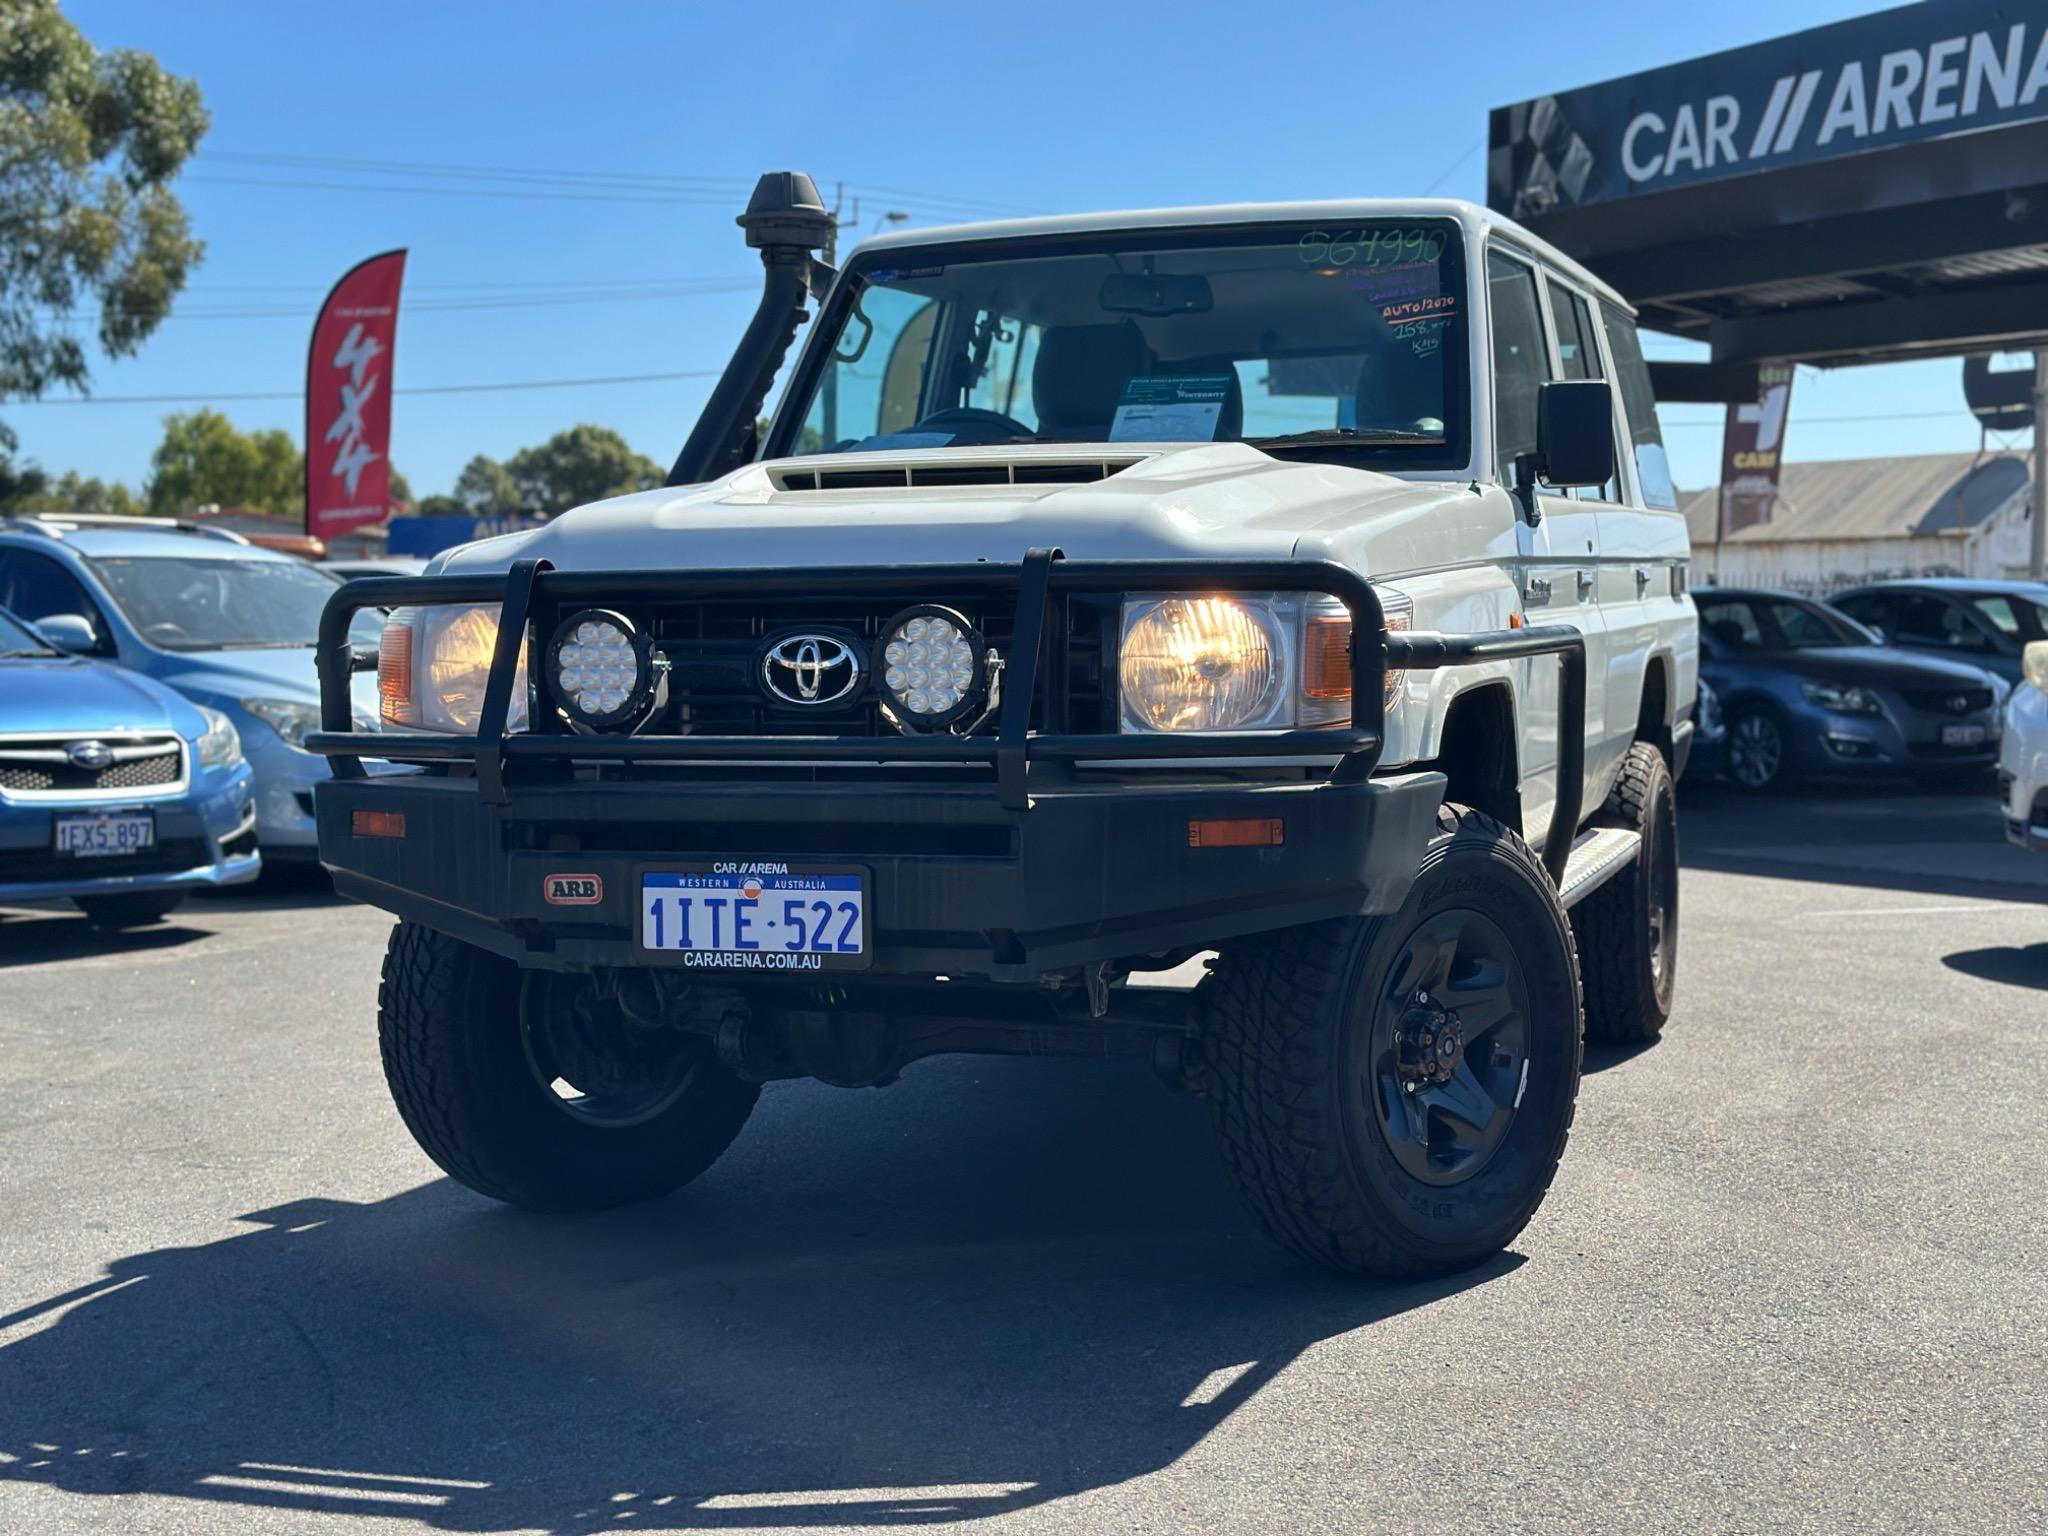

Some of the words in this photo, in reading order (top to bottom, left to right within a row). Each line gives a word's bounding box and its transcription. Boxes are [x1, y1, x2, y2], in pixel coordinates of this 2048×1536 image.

[1620, 95, 1740, 183] CAR
[1382, 295, 1456, 319] AUTO/2020
[713, 862, 737, 874] CAR
[551, 880, 595, 898] ARB
[678, 878, 730, 888] WESTERN
[774, 879, 827, 890] AUSTRALIA
[683, 951, 822, 970] CARARENA.COM.AU
